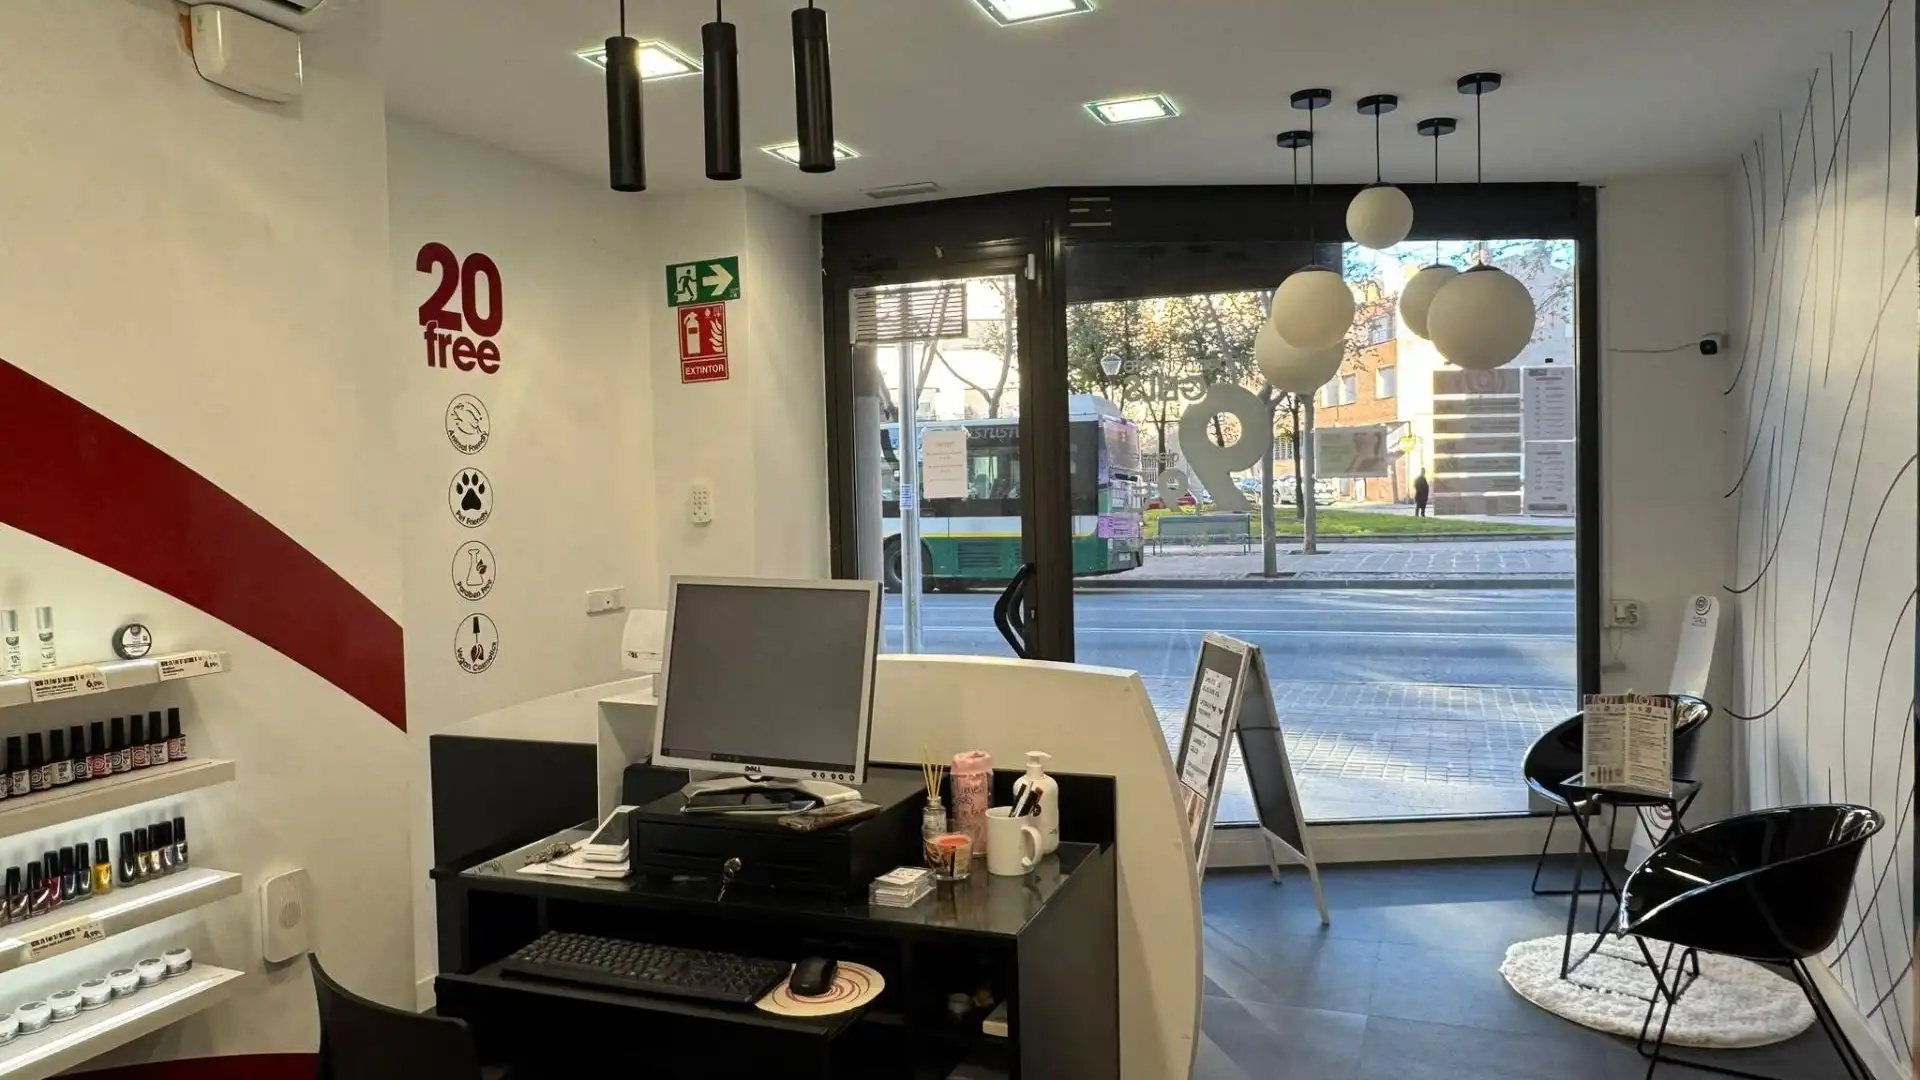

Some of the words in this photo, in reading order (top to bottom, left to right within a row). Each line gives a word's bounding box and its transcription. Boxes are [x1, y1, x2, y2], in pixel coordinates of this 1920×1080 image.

[416, 242, 503, 337] 20
[424, 321, 501, 374] free
[685, 364, 724, 375] EXTINTOR
[448, 429, 468, 451] Animal
[468, 430, 489, 452] Friendly
[456, 509, 466, 522] Pet
[466, 509, 488, 525] Friendly
[456, 580, 481, 598] Paraben
[457, 647, 472, 670] Vegan
[472, 642, 497, 671] Cosmetics
[745, 765, 762, 773] DELL
